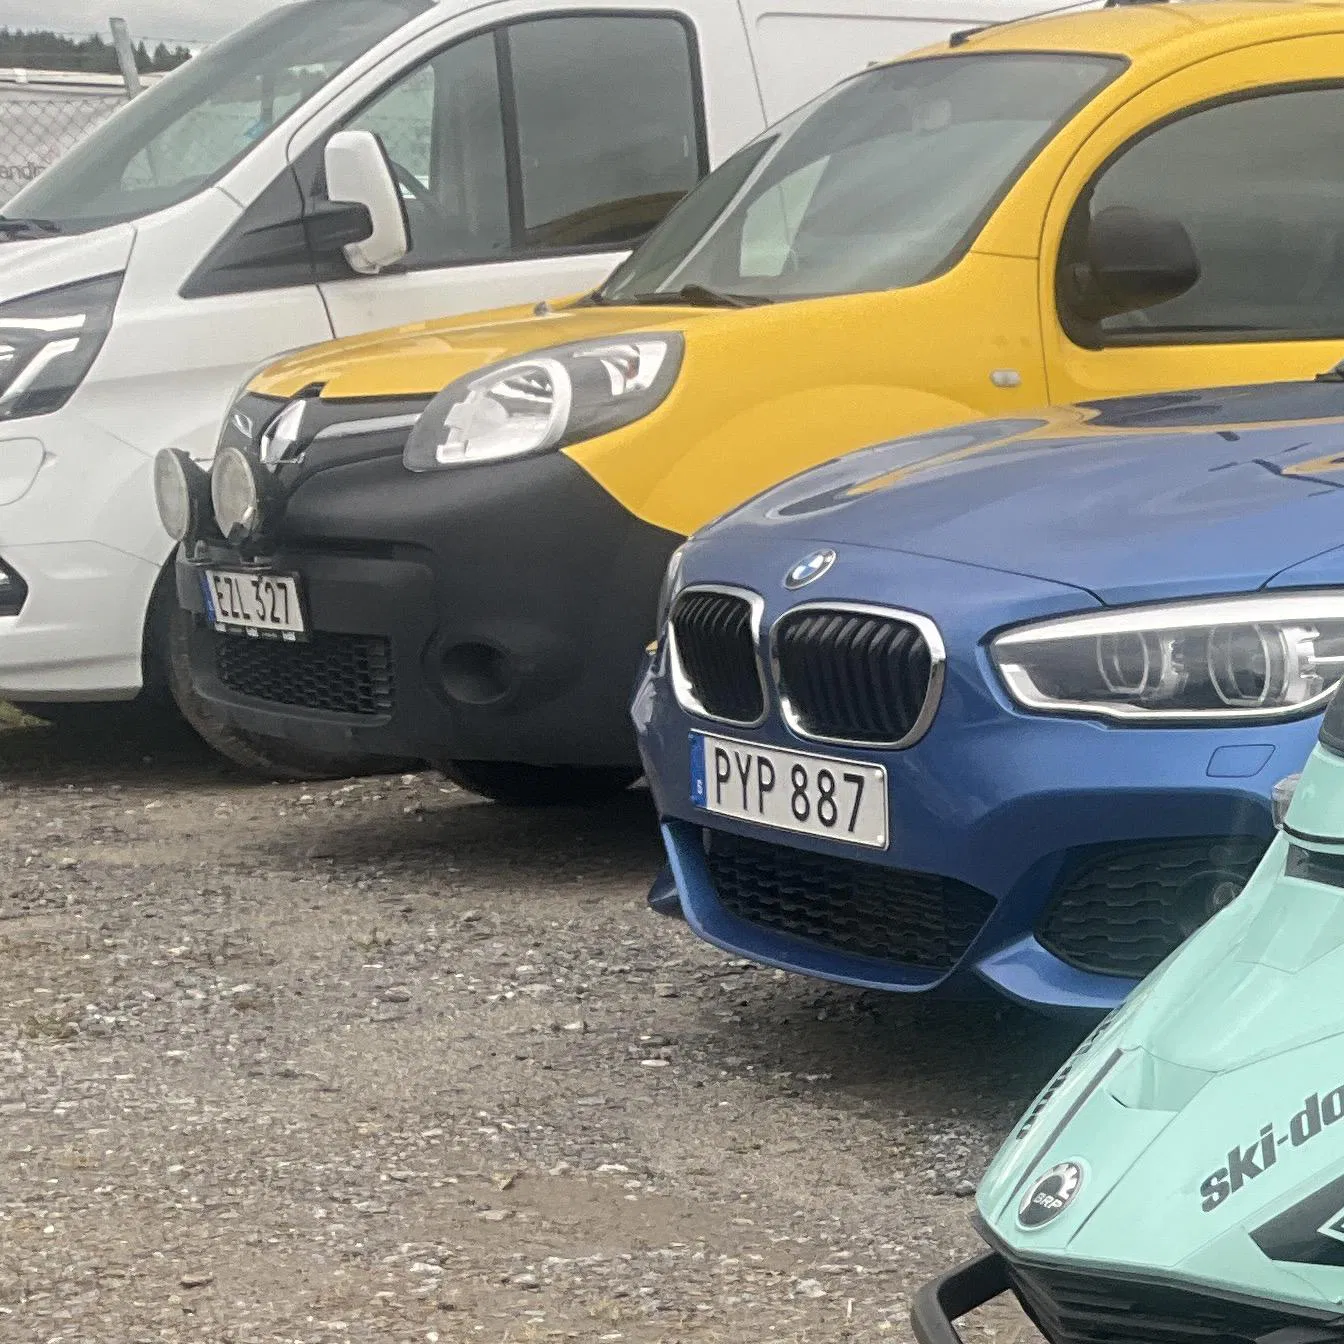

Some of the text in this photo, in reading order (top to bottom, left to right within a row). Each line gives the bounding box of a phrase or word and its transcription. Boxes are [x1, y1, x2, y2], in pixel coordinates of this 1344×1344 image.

[213, 575, 289, 625] EZL 327
[714, 747, 865, 832] PYP 887
[1032, 1192, 1064, 1209] BRP
